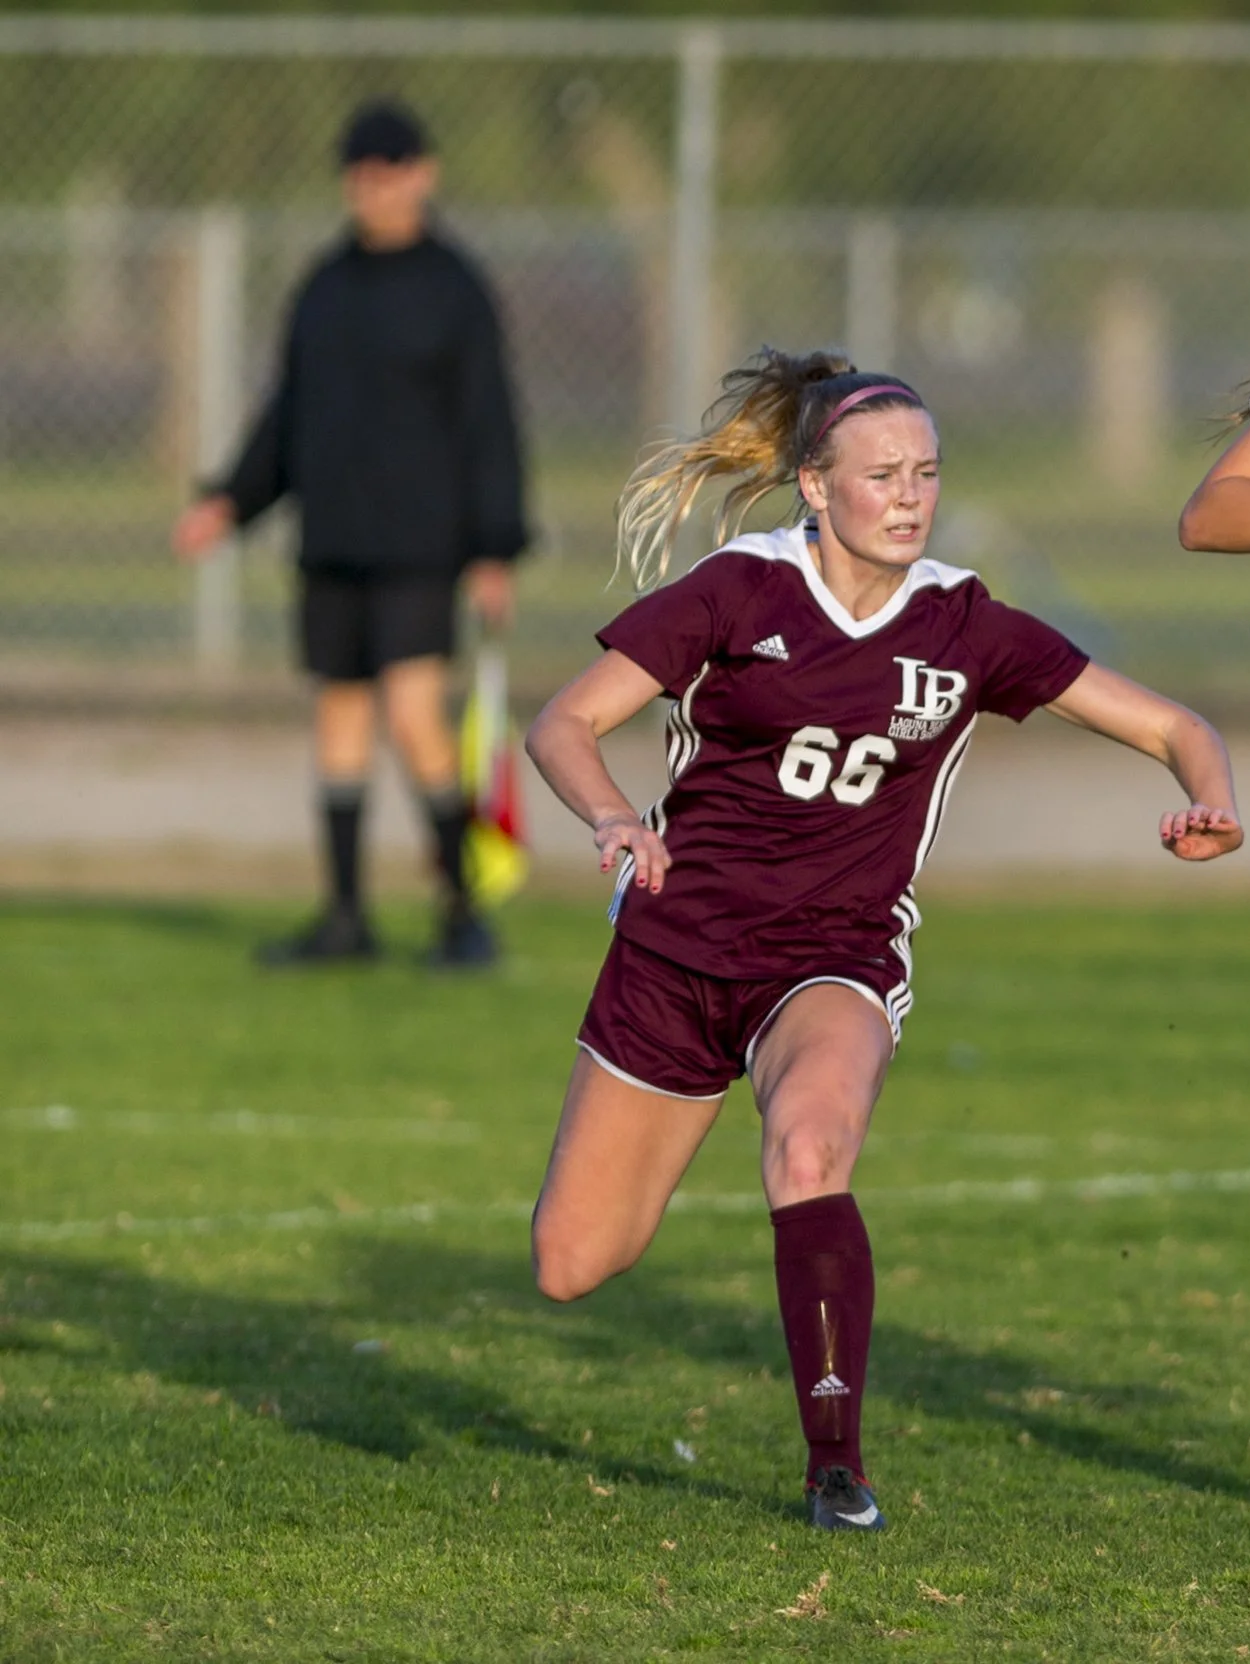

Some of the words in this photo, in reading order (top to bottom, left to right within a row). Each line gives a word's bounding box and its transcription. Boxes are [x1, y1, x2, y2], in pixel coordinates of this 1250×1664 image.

[892, 656, 968, 720] LB
[889, 715, 928, 731] LAGUNA
[887, 725, 920, 741] GIRLS
[778, 726, 896, 805] 66
[811, 1385, 850, 1397] adidas
